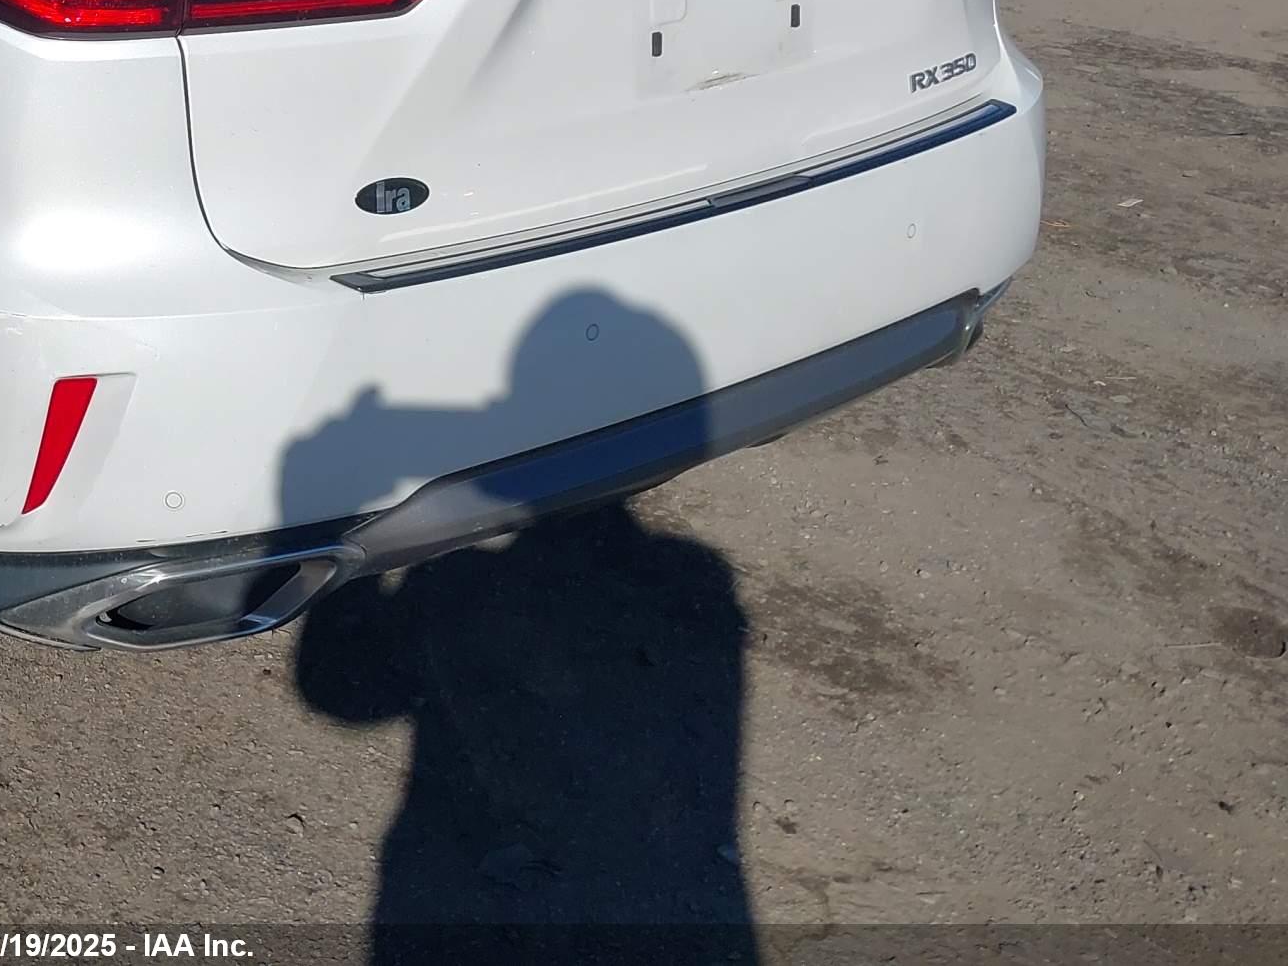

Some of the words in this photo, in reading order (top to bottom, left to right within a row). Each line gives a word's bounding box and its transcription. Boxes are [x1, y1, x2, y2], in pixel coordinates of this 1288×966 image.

[909, 65, 940, 94] RX
[939, 52, 977, 83] 350
[376, 181, 411, 213] Ira
